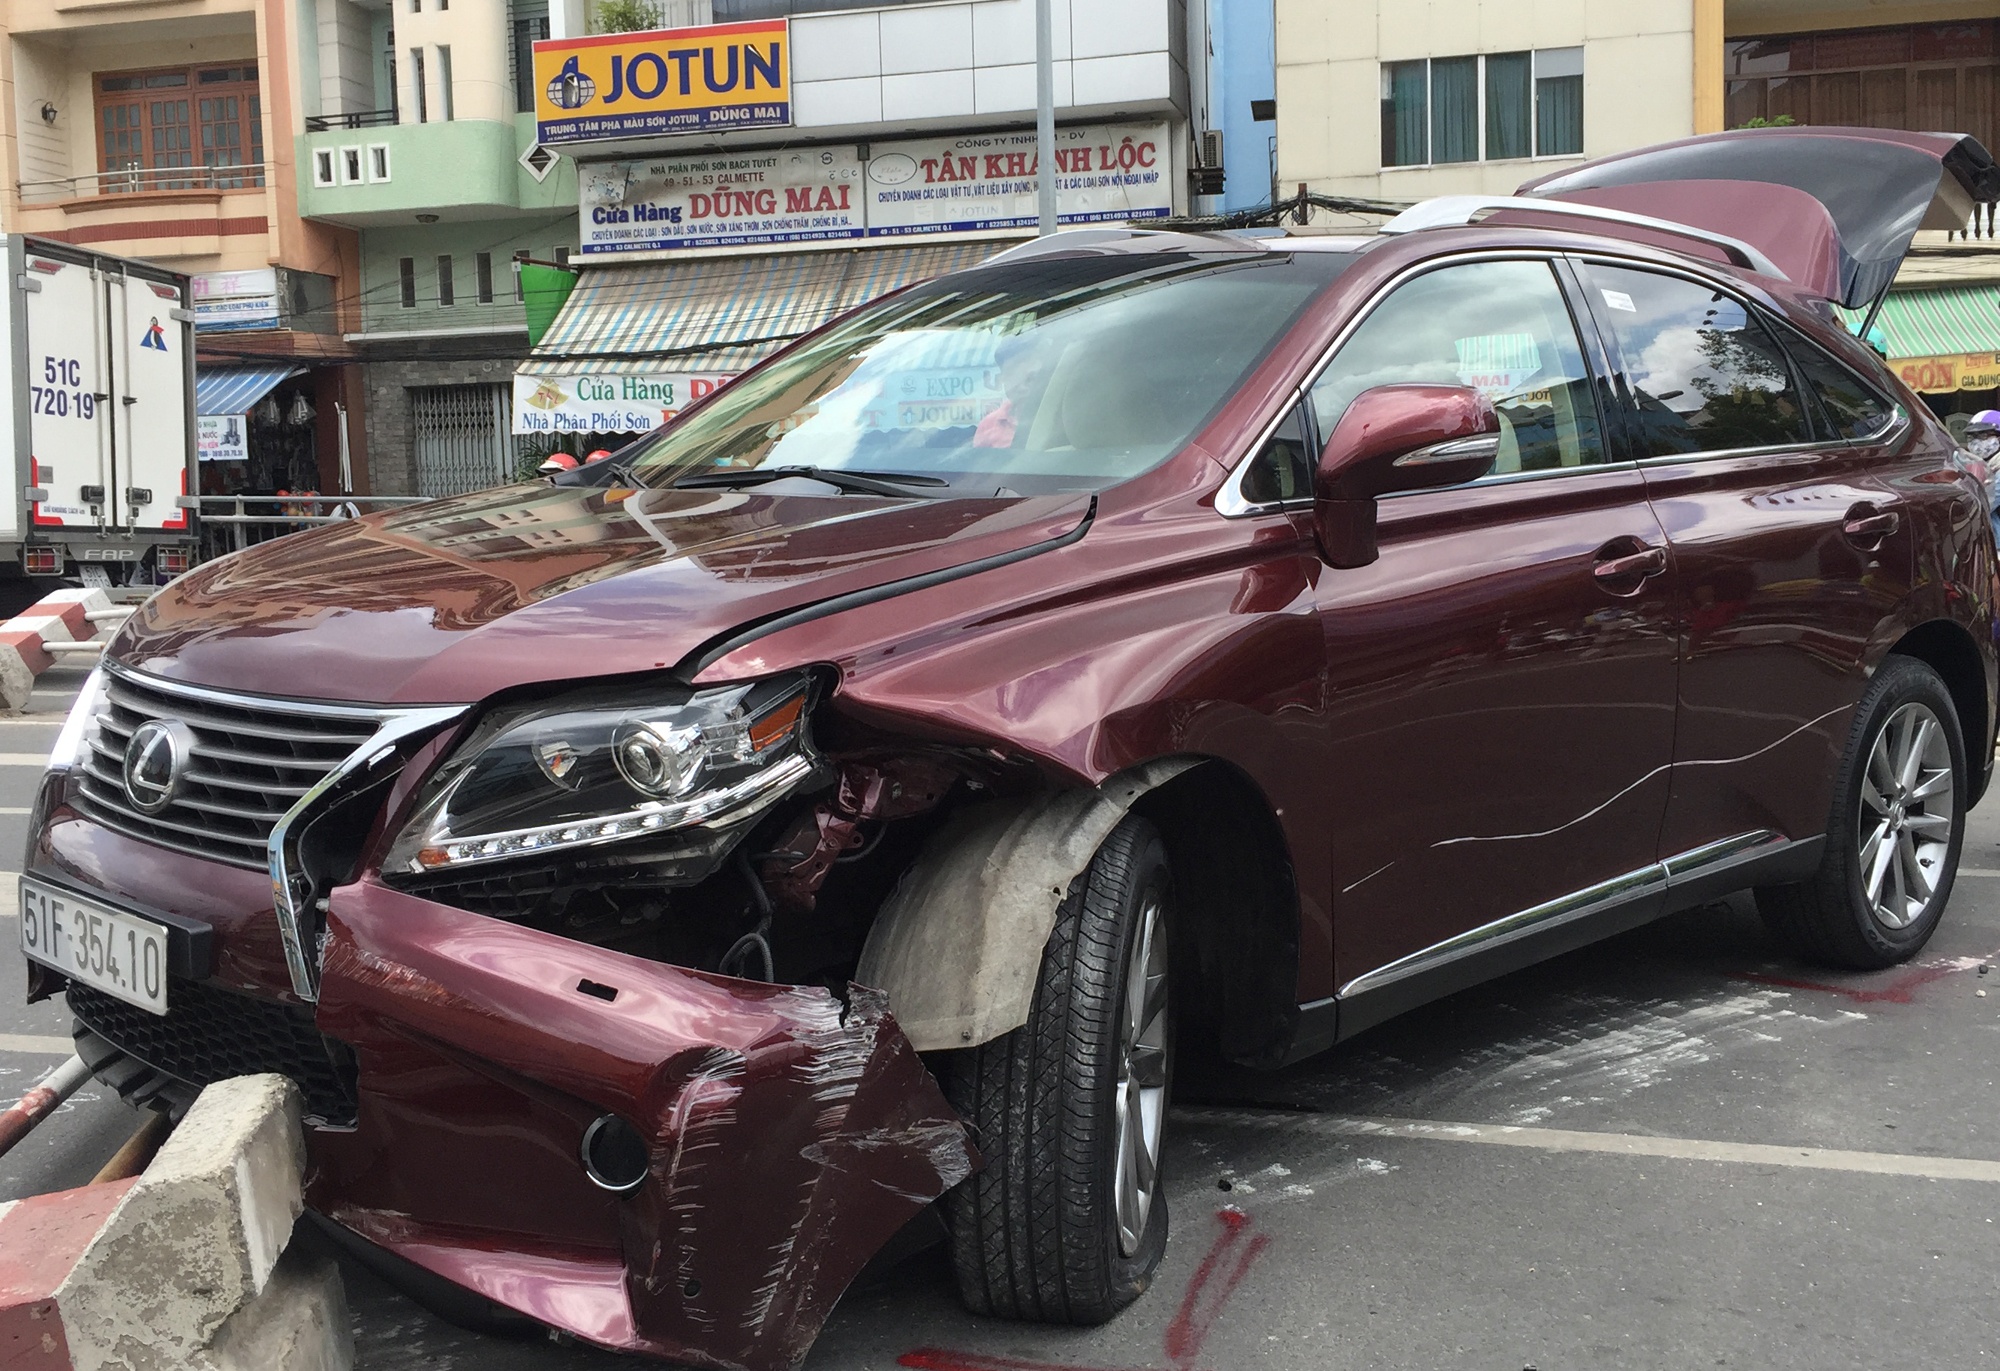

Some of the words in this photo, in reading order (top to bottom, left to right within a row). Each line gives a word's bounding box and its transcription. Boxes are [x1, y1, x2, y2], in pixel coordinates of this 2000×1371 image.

[602, 42, 781, 103] JOTUN
[545, 124, 576, 135] TRUNG
[579, 121, 598, 131] TÂM
[601, 121, 620, 130] PHA
[624, 117, 644, 128] MÀU
[647, 115, 666, 126] SƠN
[668, 114, 699, 124] JOTUN
[709, 106, 750, 121] DŨNG
[754, 107, 780, 118] MAI
[955, 135, 991, 149] CÔNG
[993, 137, 1006, 146] TY
[1070, 131, 1086, 141] DV
[650, 165, 666, 175] NHÀ
[668, 163, 689, 174] PHÂN
[690, 160, 709, 172] PHỐI
[712, 160, 728, 171] SƠN
[729, 160, 750, 172] BẠCH
[752, 155, 777, 168] TUYẾT
[919, 151, 978, 183] TÂN
[1099, 136, 1157, 173] LỘC
[663, 178, 674, 187] 49
[683, 176, 693, 186] 51
[702, 175, 714, 185] 53
[718, 171, 765, 184] CALMETTE
[902, 189, 921, 202] DOANH
[922, 186, 935, 199] CÁC
[1001, 181, 1013, 194] XÂY
[592, 203, 629, 225] Cửa
[633, 202, 682, 224] Hàng
[689, 186, 777, 219] DŨNG
[785, 185, 851, 213] MAI
[45, 356, 81, 387] 51C
[1471, 374, 1510, 387] MAI
[1902, 359, 1953, 389] SƠN
[1962, 375, 1976, 387] GIA
[577, 375, 615, 401] Cửa
[622, 376, 674, 405] Hàng
[926, 376, 974, 397] EXPO
[1530, 390, 1551, 401] JOT
[31, 387, 94, 420] 720.19
[919, 405, 973, 423] JOTUN
[522, 412, 549, 429] Nhà
[554, 413, 587, 430] Phân
[592, 410, 621, 429] Phối
[625, 413, 650, 429] Sơn
[25, 888, 159, 999] 51F-354.10
